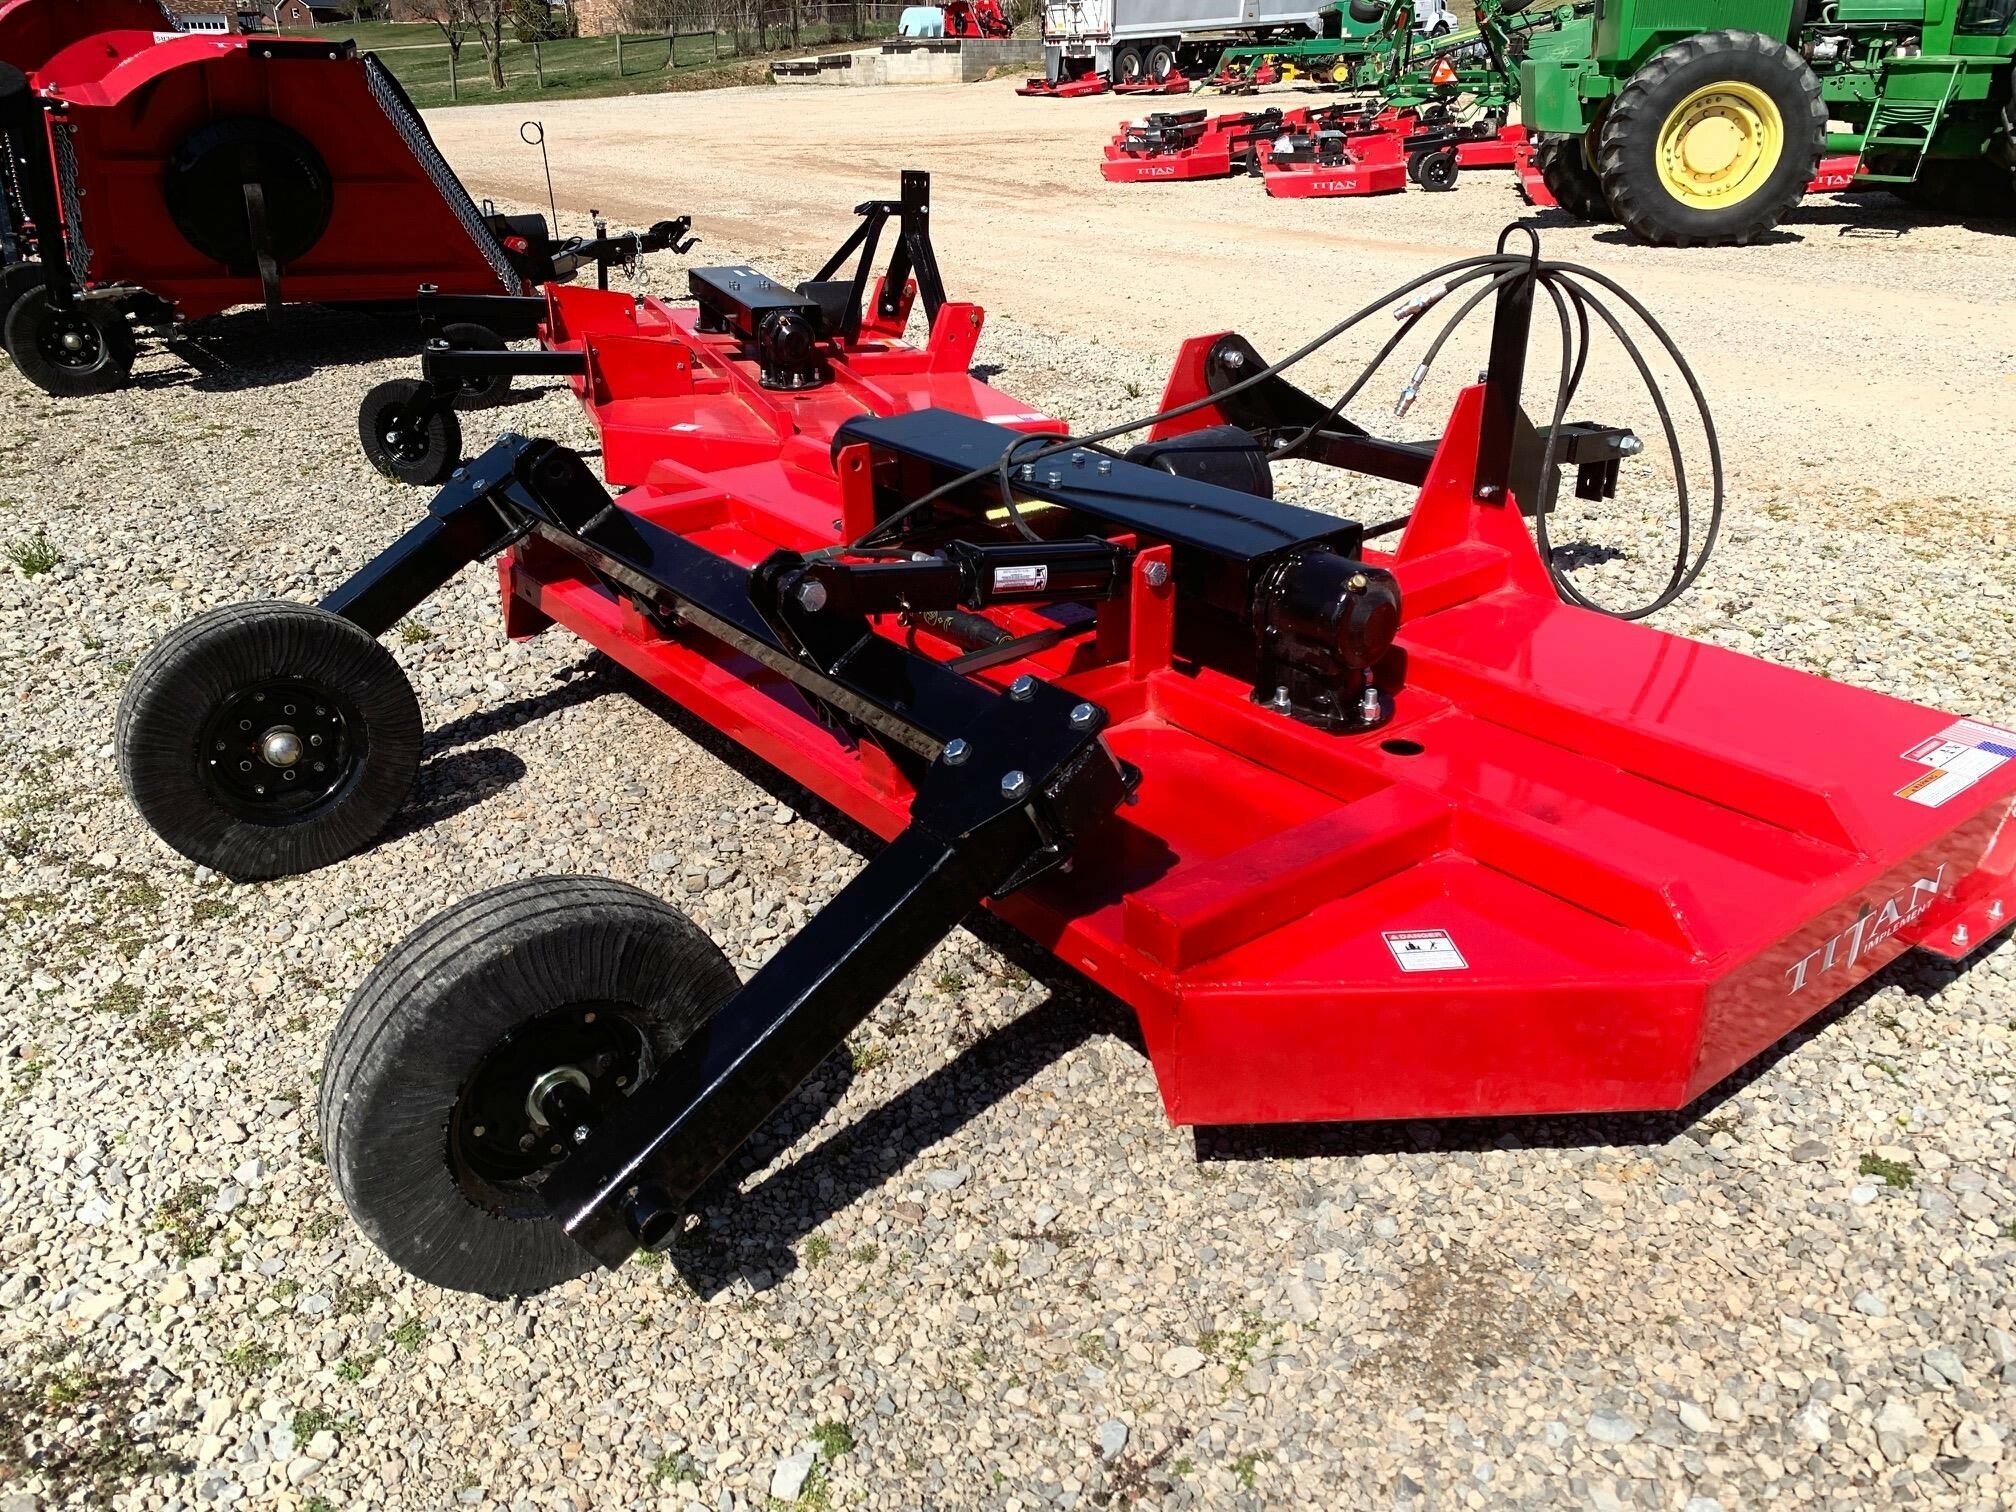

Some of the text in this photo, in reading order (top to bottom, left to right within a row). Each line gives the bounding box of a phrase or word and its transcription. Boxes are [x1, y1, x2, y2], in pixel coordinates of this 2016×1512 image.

[1136, 165, 1175, 177] TITAN
[1311, 179, 1358, 191] TITAN
[1815, 174, 1854, 186] ITAN
[1785, 861, 1948, 996] TITAN
